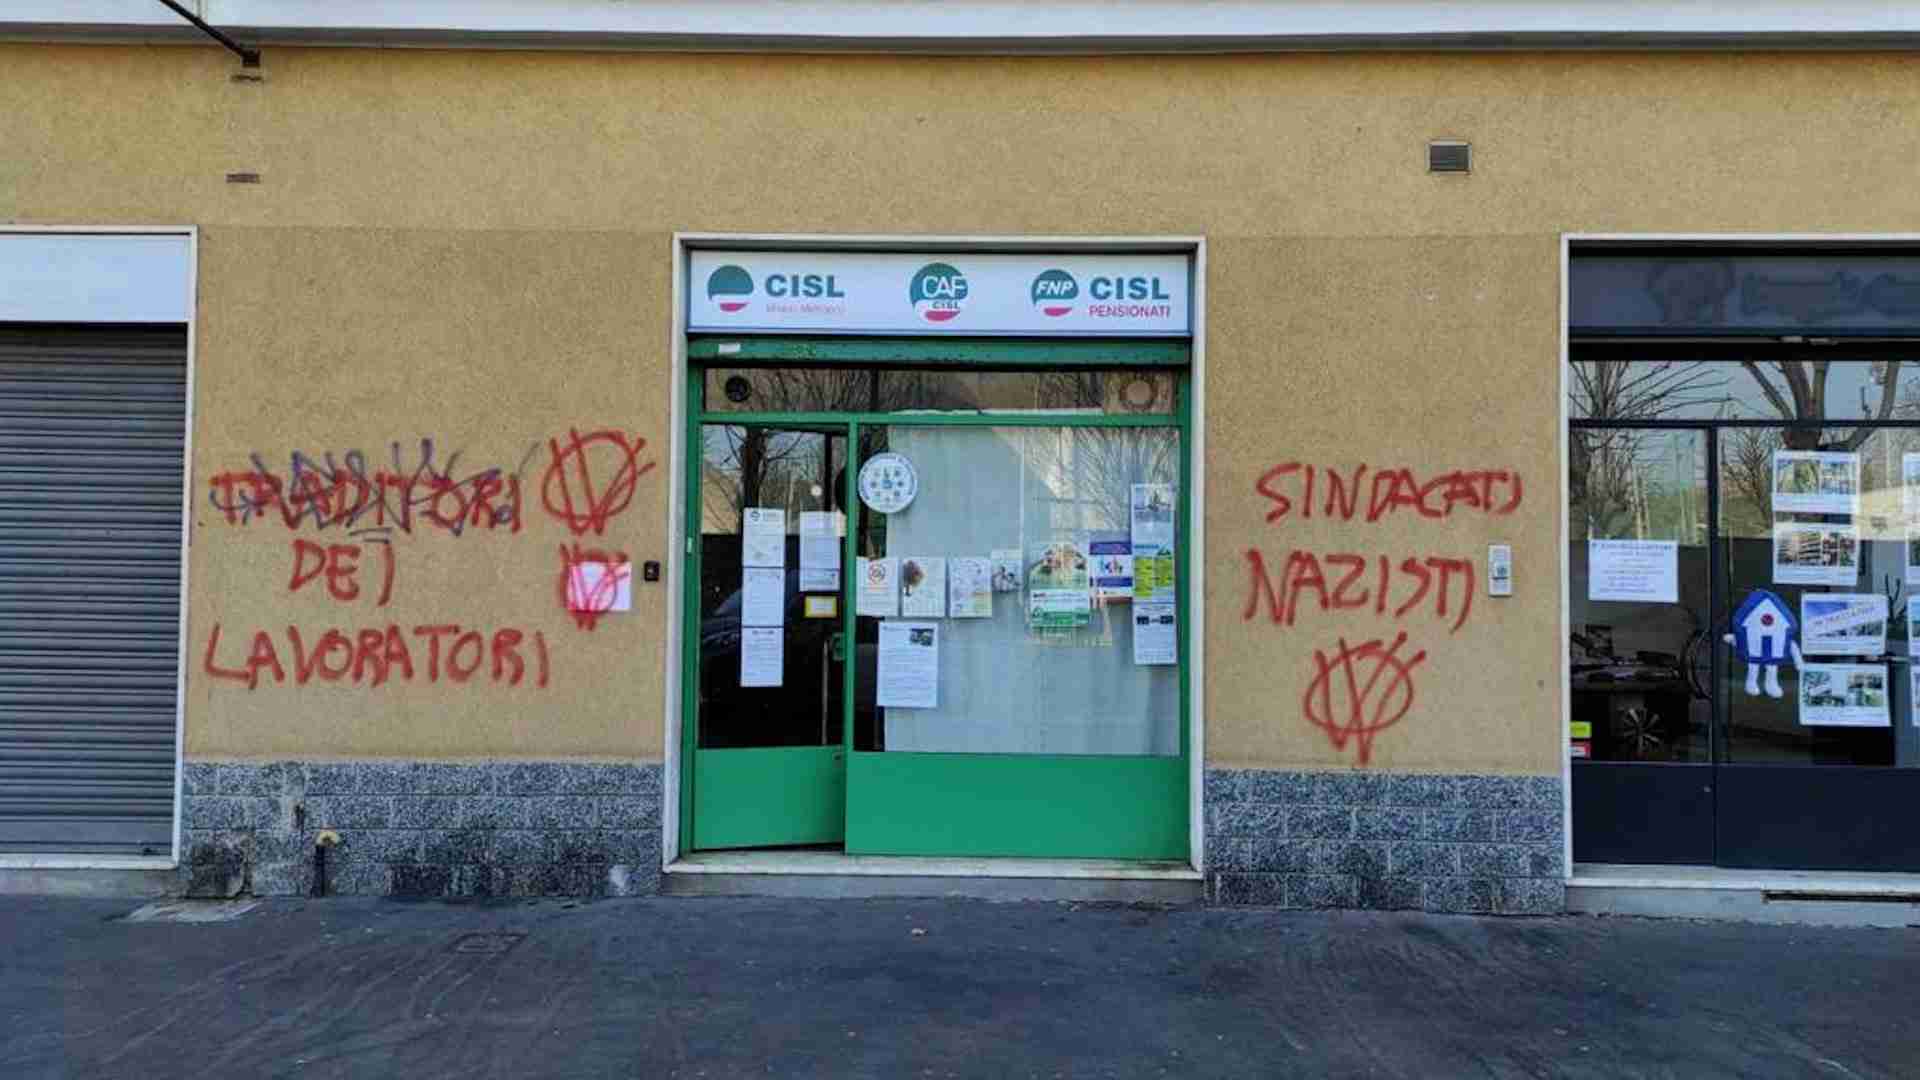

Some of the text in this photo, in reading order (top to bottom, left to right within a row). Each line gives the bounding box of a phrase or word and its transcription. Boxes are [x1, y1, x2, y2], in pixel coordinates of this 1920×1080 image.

[765, 274, 845, 297] CISL
[922, 276, 966, 298] CAF
[1036, 280, 1073, 296] FNP
[1090, 277, 1169, 300] CISL
[1089, 305, 1170, 317] PENSIONATI
[1256, 463, 1523, 523] SINDACATI
[1245, 548, 1475, 634] NAZISTI
[204, 623, 549, 689] LAVORATORI
